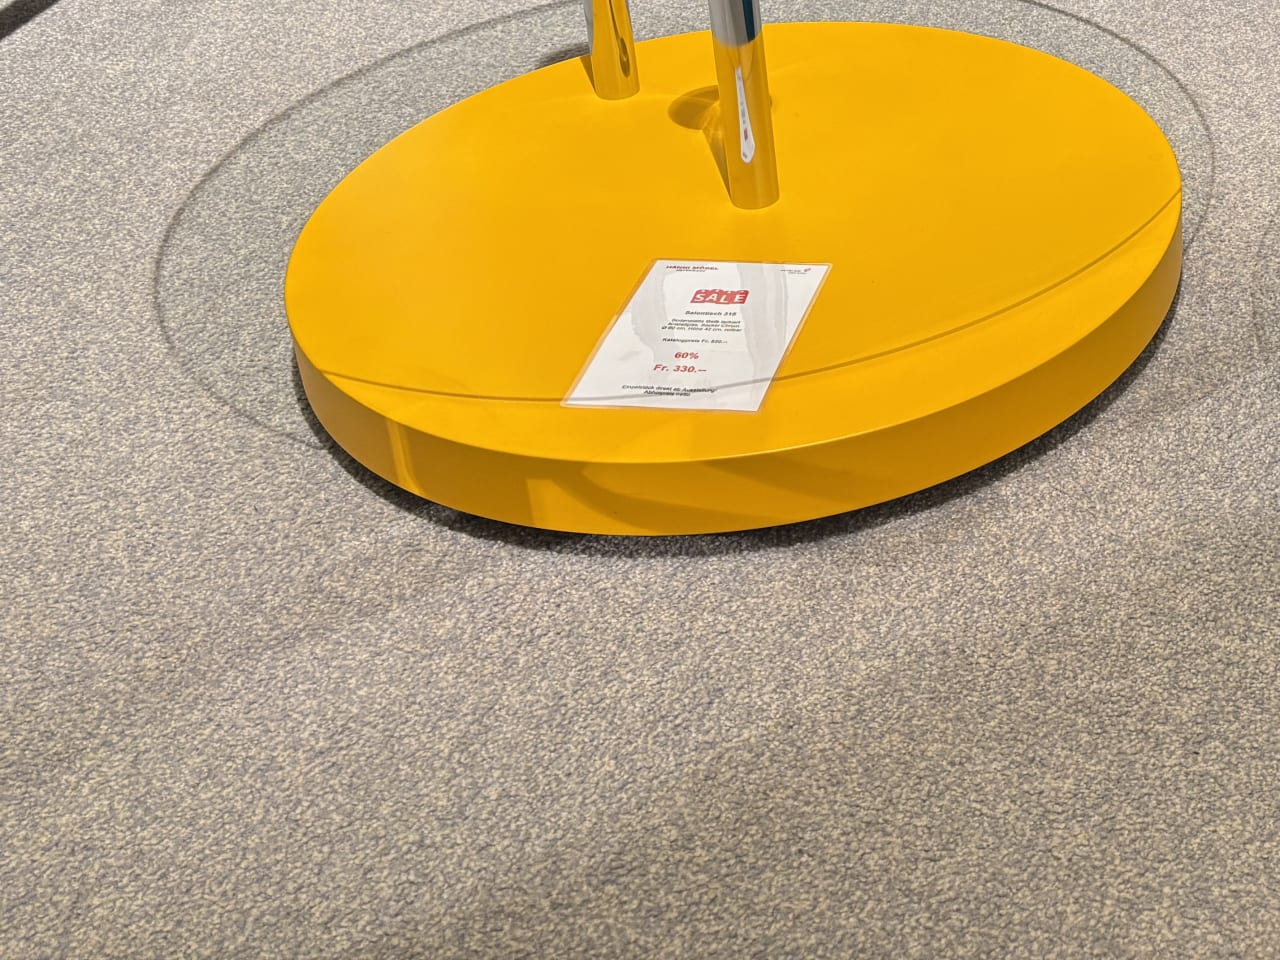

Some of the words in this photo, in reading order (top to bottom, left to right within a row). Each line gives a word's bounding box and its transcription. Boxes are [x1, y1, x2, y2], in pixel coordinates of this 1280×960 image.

[693, 292, 746, 304] SALE
[674, 351, 699, 359] 60%
[653, 364, 669, 372] Fr.
